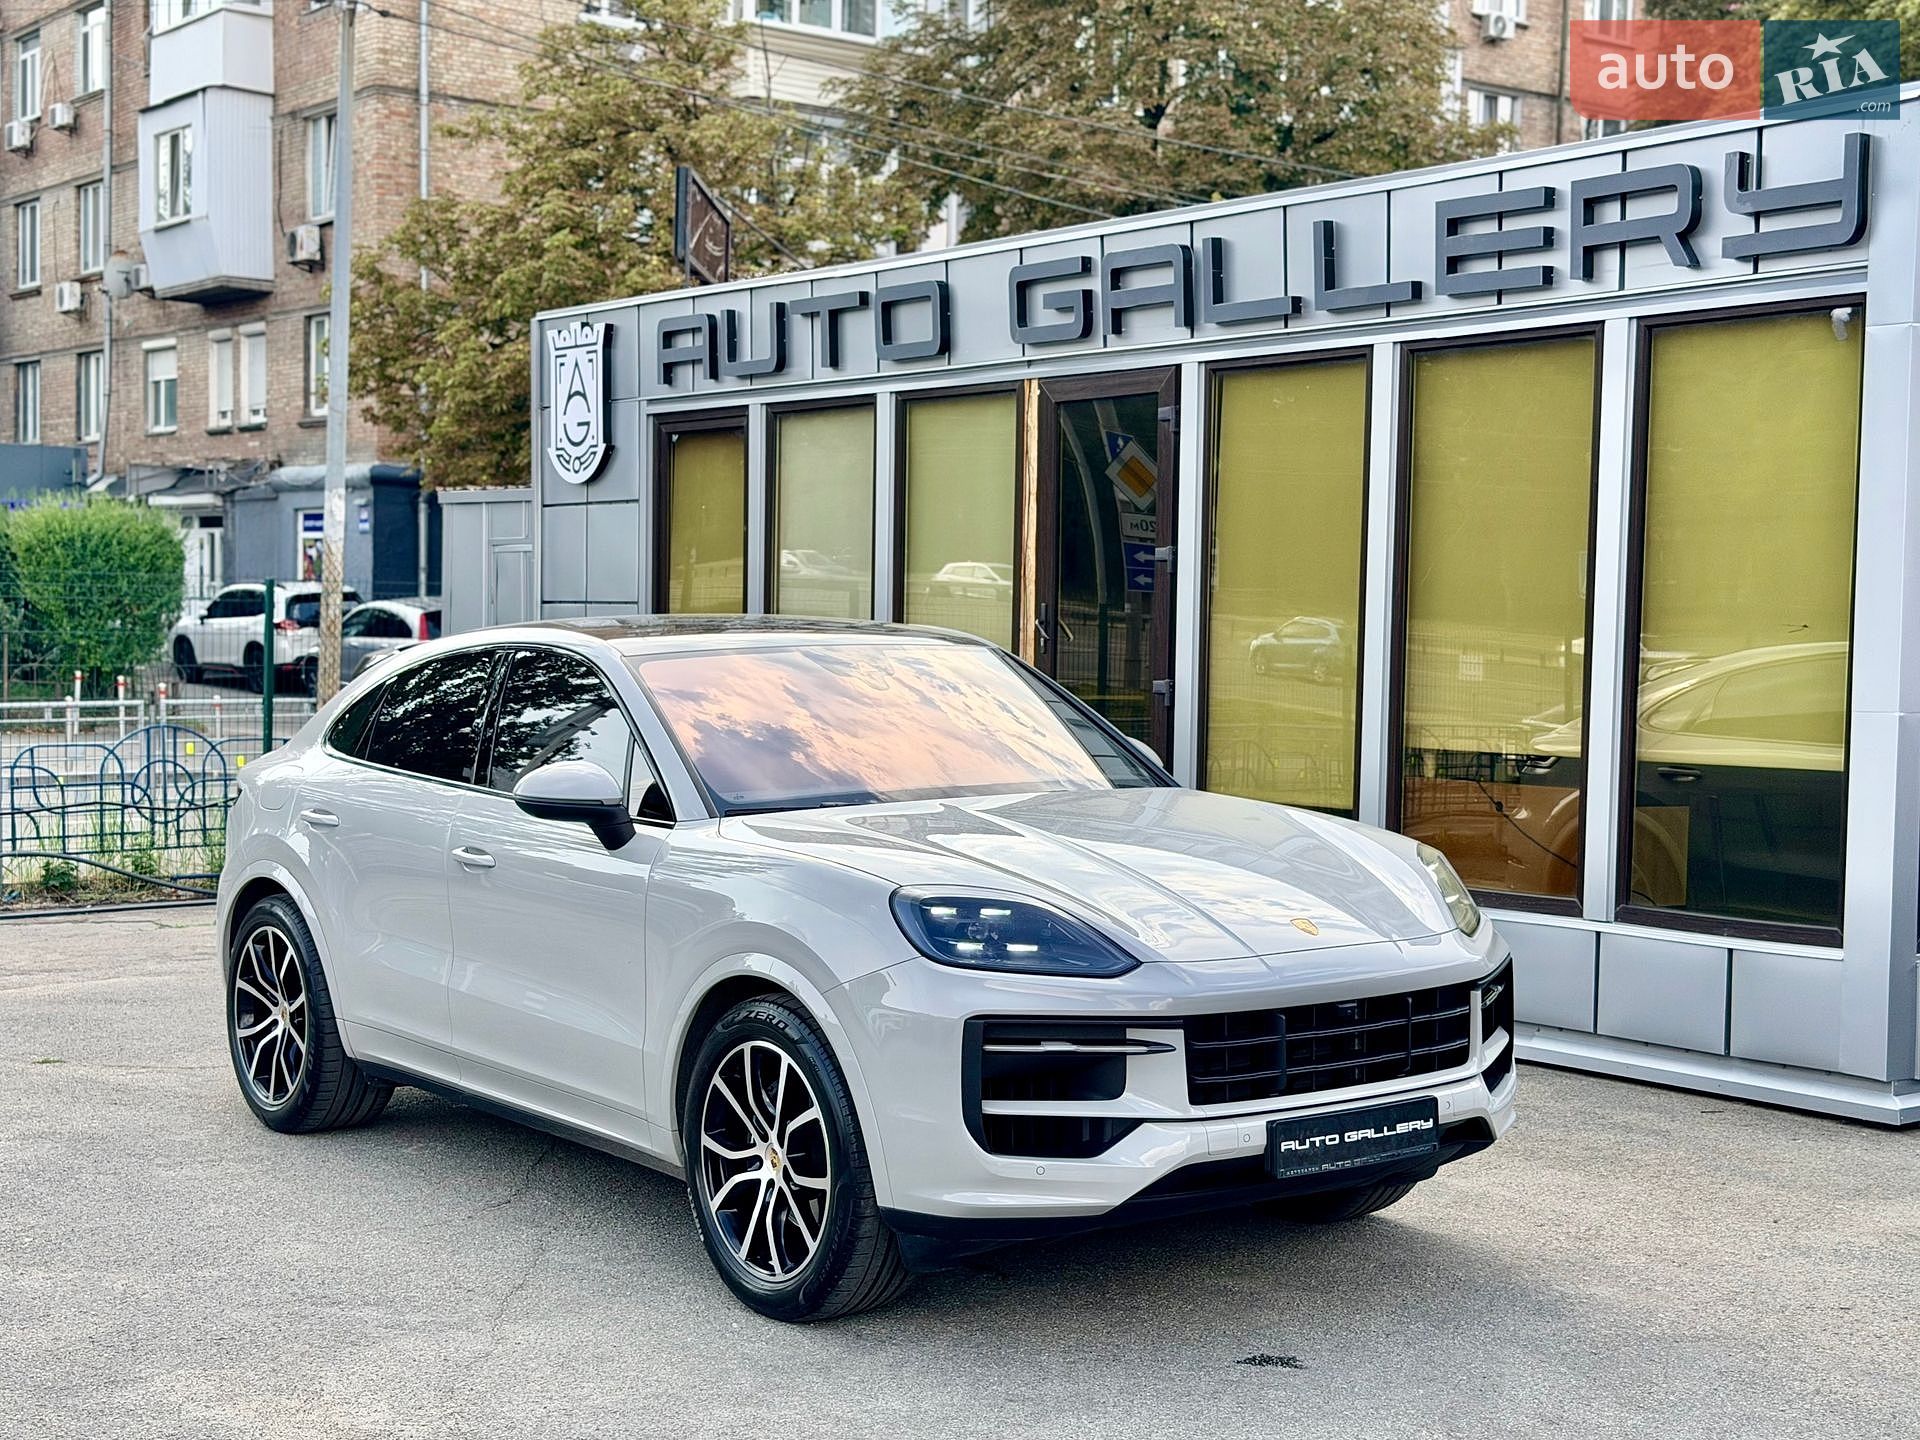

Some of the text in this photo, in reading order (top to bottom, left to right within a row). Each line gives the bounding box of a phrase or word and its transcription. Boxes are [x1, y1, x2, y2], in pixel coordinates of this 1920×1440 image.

[657, 132, 1869, 386] AUTO GALLERY
[744, 1010, 789, 1032] ZERO
[1280, 1117, 1434, 1152] AUTO GALLERY
